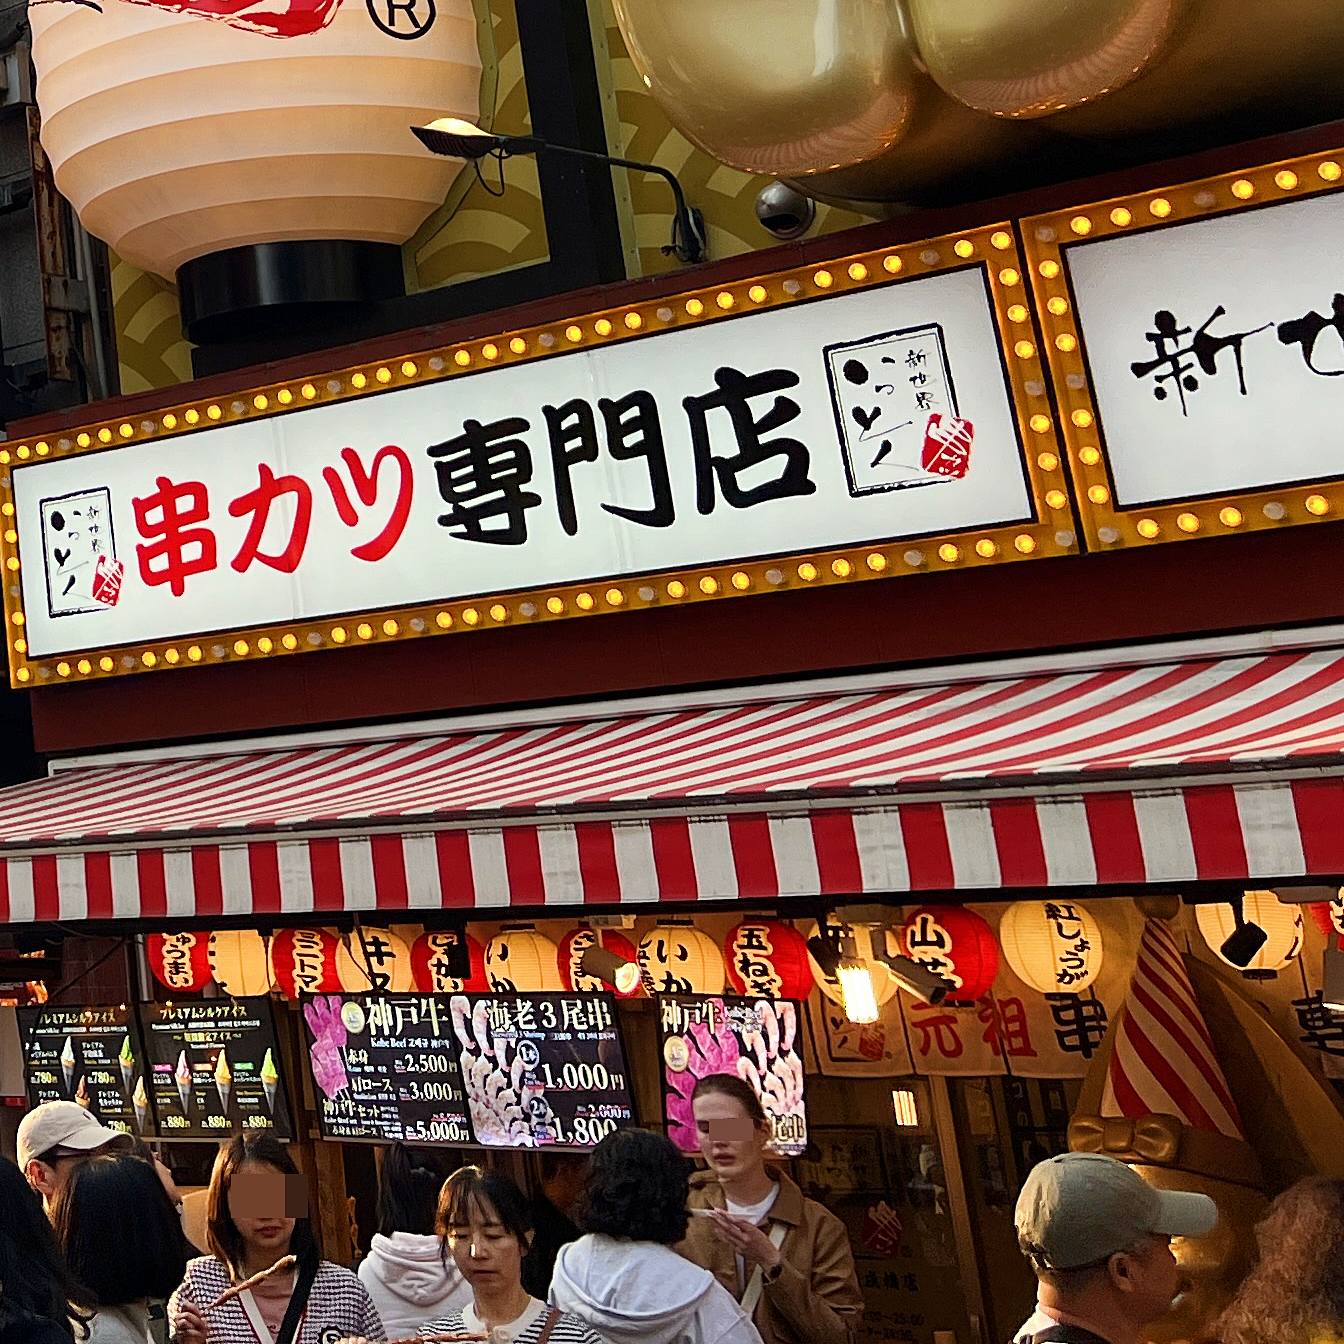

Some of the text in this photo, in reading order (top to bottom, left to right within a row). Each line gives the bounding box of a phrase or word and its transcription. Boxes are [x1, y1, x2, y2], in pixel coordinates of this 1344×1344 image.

[131, 365, 818, 598] 串カツ専門店
[1044, 902, 1093, 985] 紅しょうが
[366, 996, 449, 1037] 神戸牛
[487, 998, 613, 1032] 海老3尾串
[410, 1081, 463, 1101] 3,000円
[541, 1063, 625, 1091] 1,000円
[416, 1120, 470, 1141] 5,000円
